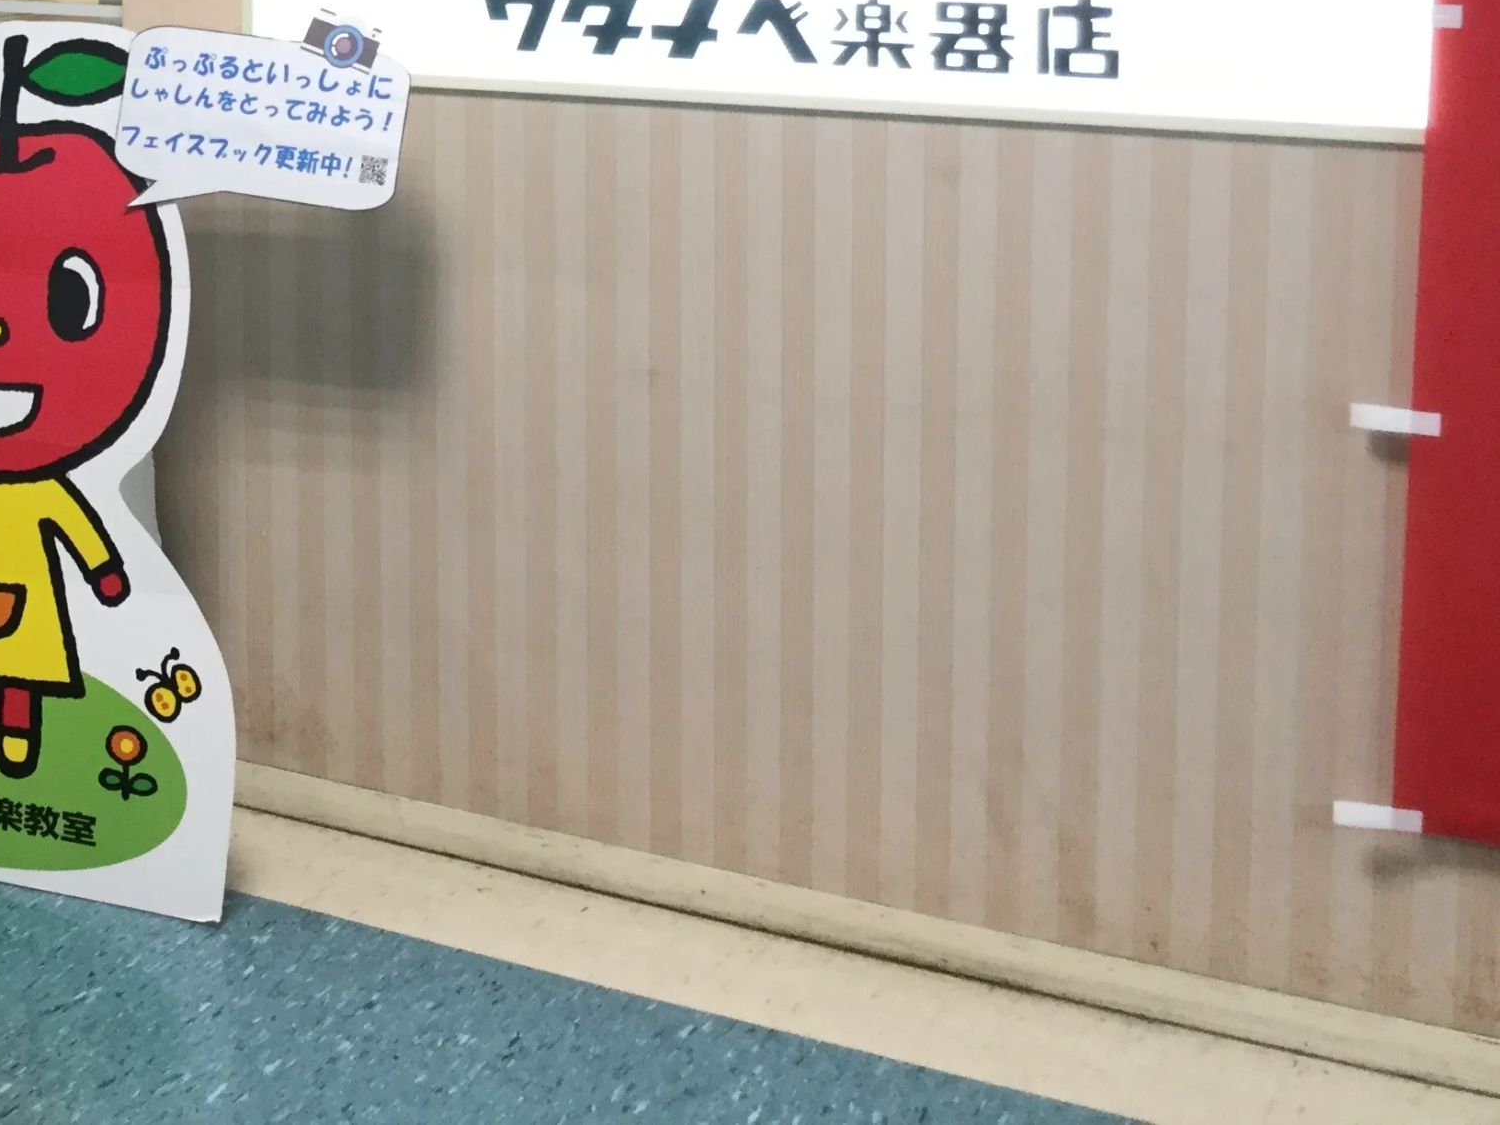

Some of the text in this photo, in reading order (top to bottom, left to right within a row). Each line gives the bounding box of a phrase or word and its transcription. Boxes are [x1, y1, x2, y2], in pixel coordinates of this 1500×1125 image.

[144, 46, 394, 100] ぷっぷるといっしょに
[130, 78, 394, 132] しゃしんをとってみよう!
[121, 125, 355, 179] フェイスブック更新中!
